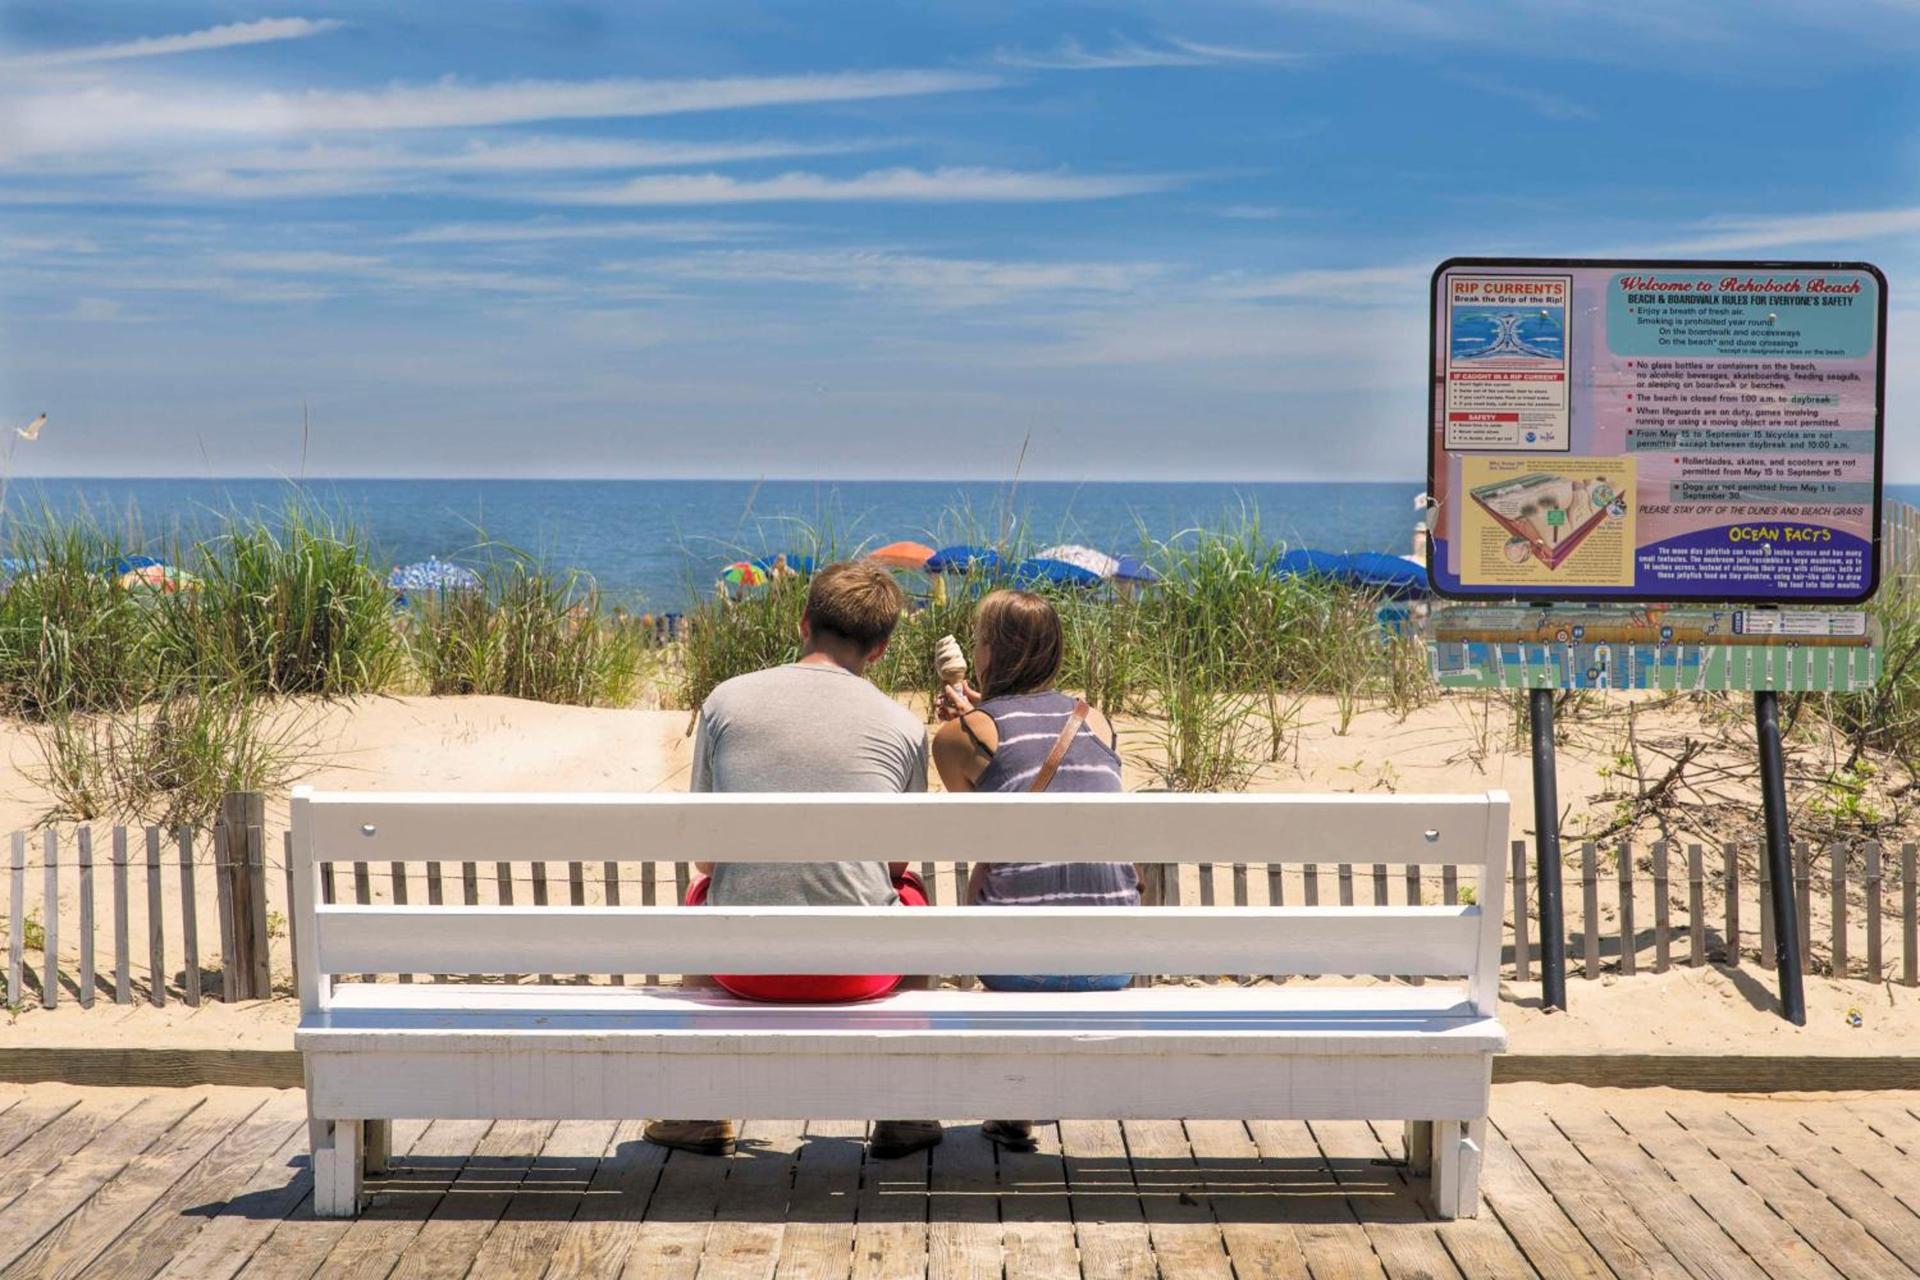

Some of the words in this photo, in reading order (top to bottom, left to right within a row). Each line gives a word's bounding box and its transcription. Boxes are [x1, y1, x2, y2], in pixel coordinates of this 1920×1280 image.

[1455, 283, 1478, 293] RIP
[1484, 283, 1562, 294] CURRENTS
[1620, 276, 1692, 292] Welcome
[1696, 279, 1712, 292] to
[1718, 277, 1802, 292] Rehoboth
[1807, 278, 1861, 294] Beach
[1498, 296, 1516, 304] Grip
[1628, 295, 1656, 304] BEACH
[1658, 295, 1666, 304] &
[1668, 295, 1720, 305] BOARDWALK
[1722, 296, 1748, 305] RULES
[1750, 296, 1767, 305] FOR
[1822, 296, 1852, 306] SAFETY
[1638, 307, 1660, 316] Enjoy
[1638, 318, 1674, 326] Smoking
[1684, 318, 1726, 327] prohibited
[1759, 339, 1798, 349] crossings
[1647, 381, 1681, 390] sleeping
[1790, 395, 1830, 404] daybreak
[1662, 408, 1702, 417] lifeguards
[1784, 408, 1818, 418] involving
[1636, 418, 1665, 427] running
[1678, 418, 1700, 427] using
[1710, 418, 1738, 427] moving
[1740, 418, 1766, 428] object
[1660, 430, 1678, 439] May
[1705, 431, 1750, 439] September
[1765, 431, 1800, 440] bicycles
[1682, 468, 1721, 477] permitted
[1744, 468, 1762, 477] May
[1787, 468, 1830, 478] September
[1682, 492, 1726, 501] September
[1640, 506, 1671, 514] PLEASE
[1673, 506, 1694, 514] STAY
[1696, 506, 1713, 514] OFF
[1715, 506, 1728, 514] OF
[1730, 506, 1746, 514] THE
[1748, 507, 1778, 515] DUNES
[1801, 507, 1831, 515] BEACH
[1833, 507, 1863, 515] GRASS
[1728, 526, 1778, 542] OCEAN
[1784, 527, 1832, 542] FACTS
